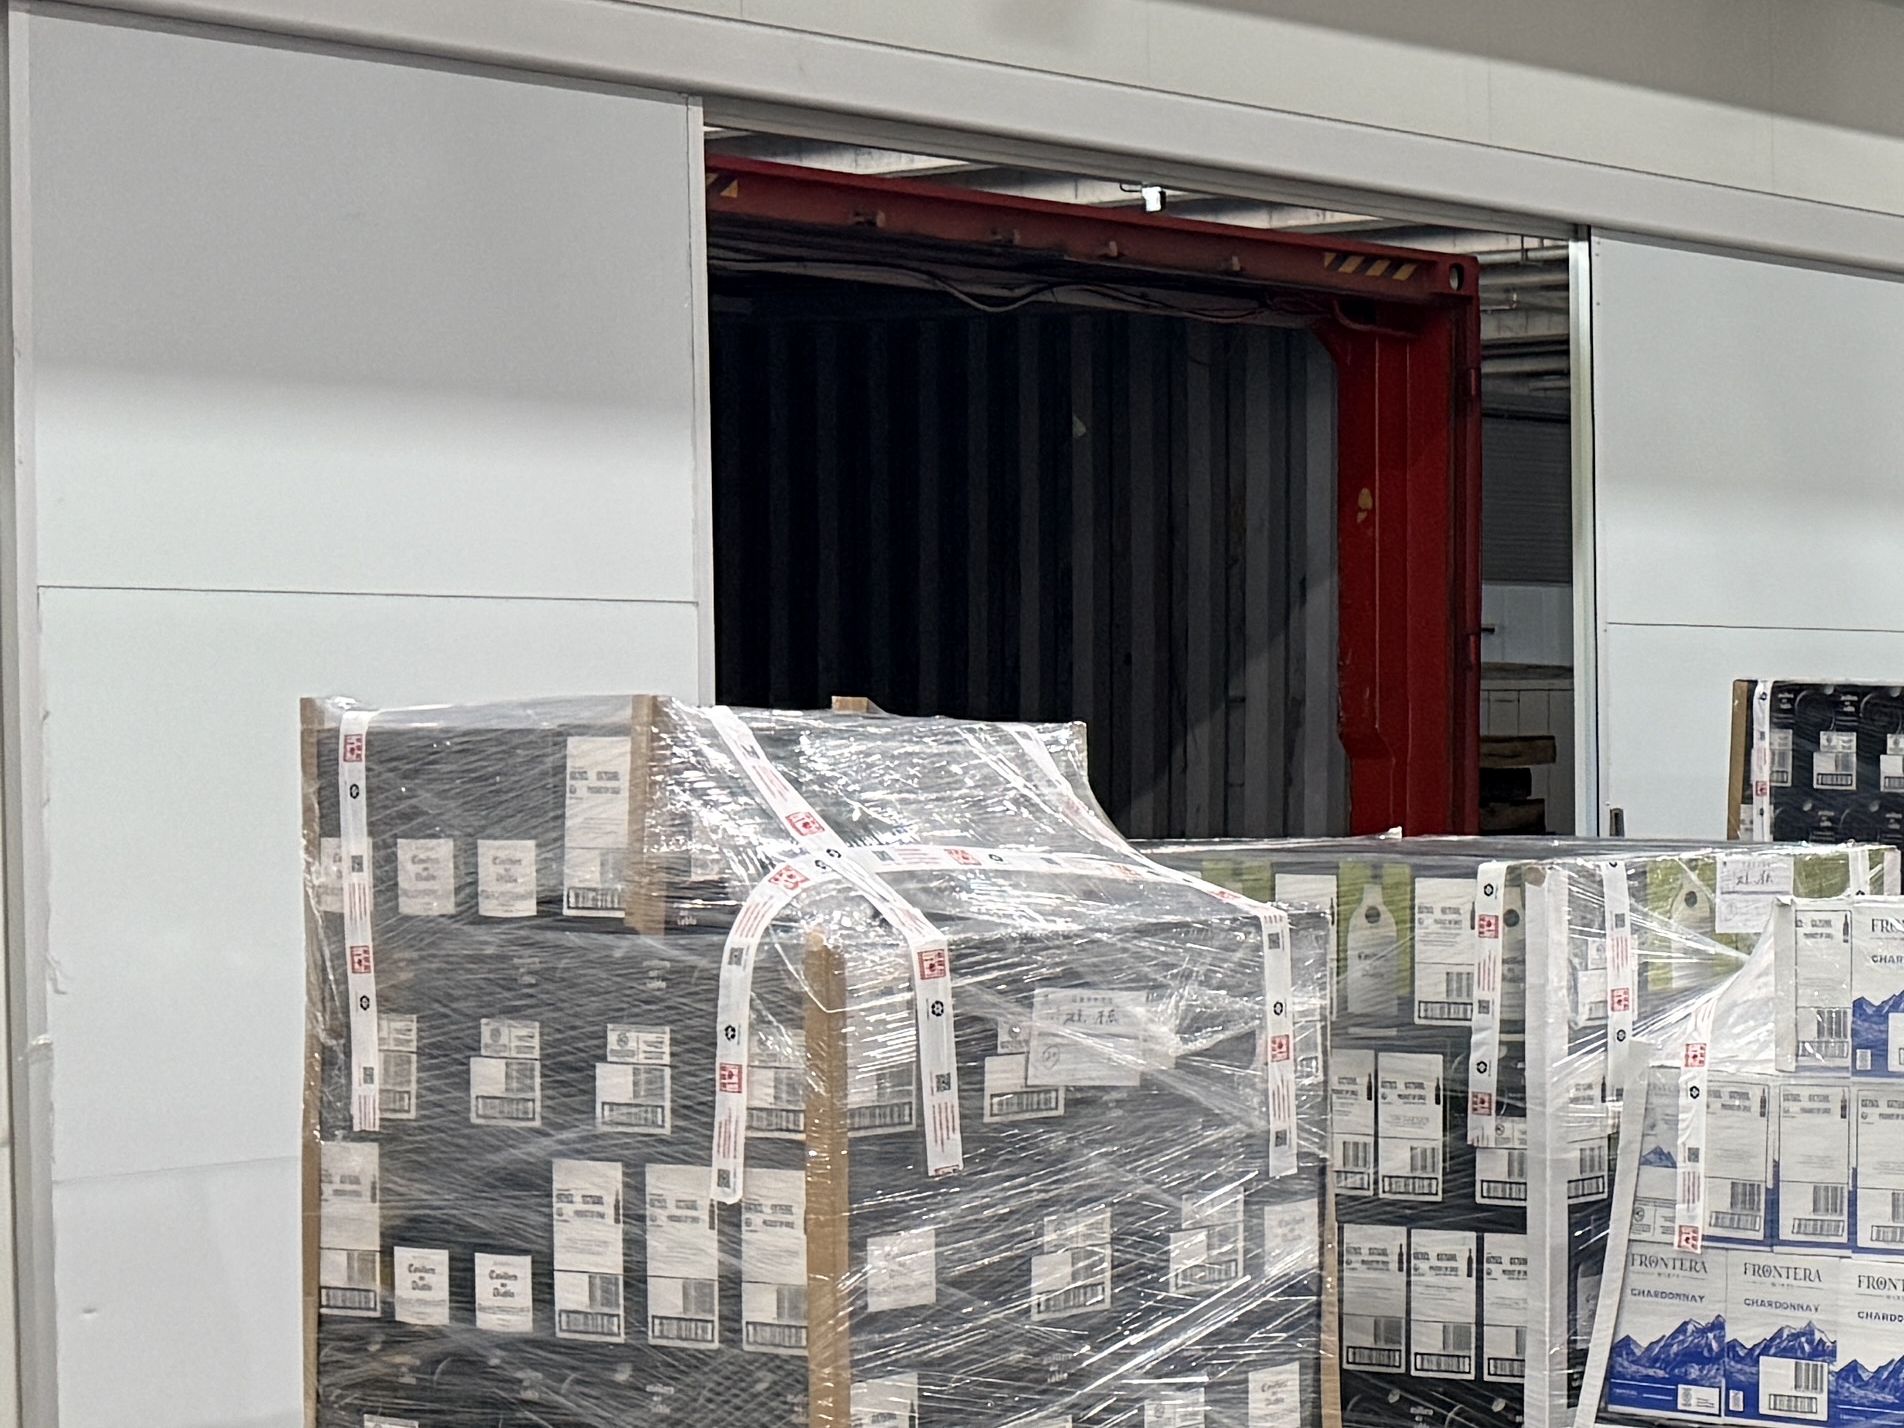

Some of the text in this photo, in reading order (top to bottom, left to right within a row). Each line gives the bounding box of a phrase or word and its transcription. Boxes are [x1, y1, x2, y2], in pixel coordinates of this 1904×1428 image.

[1630, 1253, 1708, 1274] FRONTERA
[1743, 1262, 1823, 1282] FRONTERA
[1630, 1288, 1706, 1303] CHARDONNAY
[1743, 1297, 1821, 1313] CHARDONNAY
